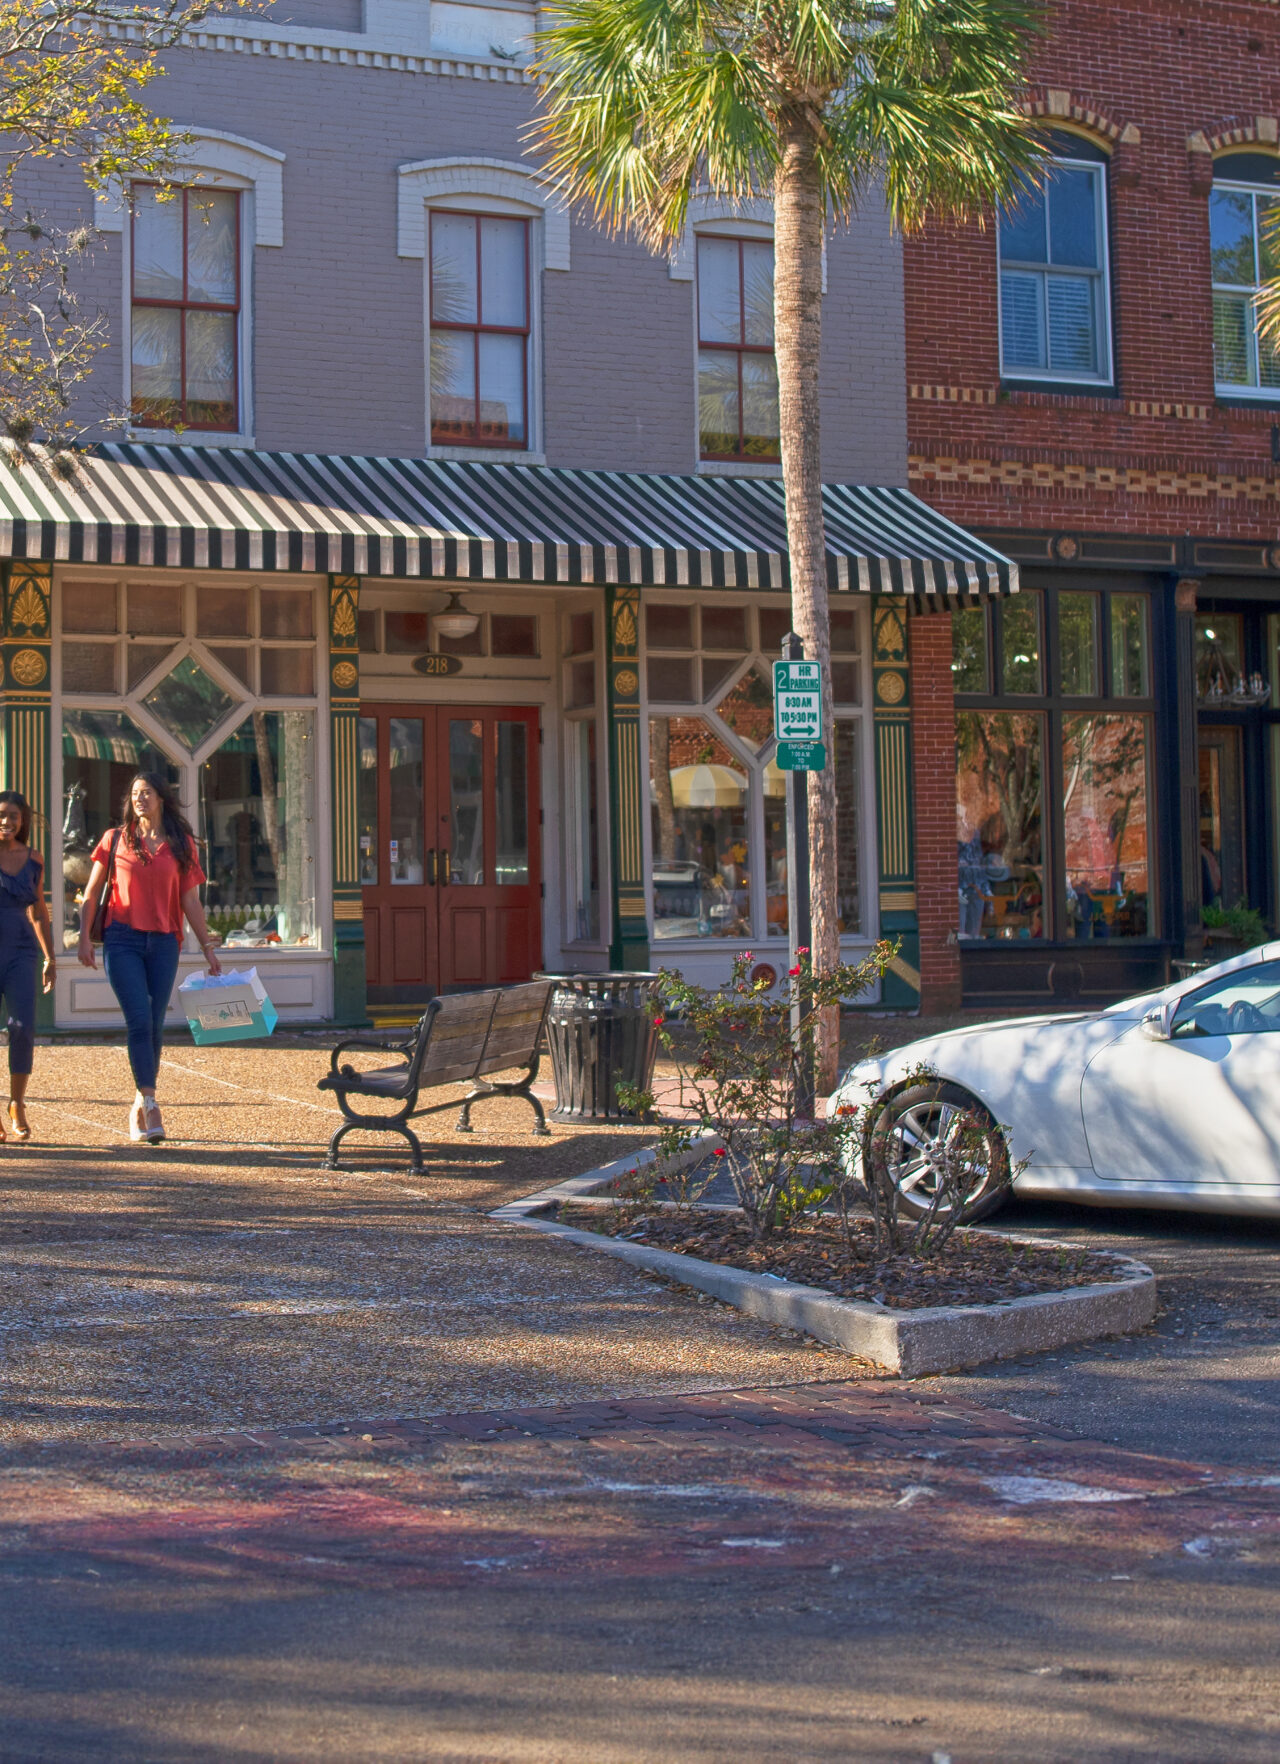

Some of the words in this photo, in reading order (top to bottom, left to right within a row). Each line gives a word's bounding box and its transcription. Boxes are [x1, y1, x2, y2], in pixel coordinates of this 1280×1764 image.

[426, 657, 449, 673] 218
[777, 669, 787, 689] 2
[798, 666, 811, 676] HR
[790, 678, 819, 689] PARKING
[785, 697, 801, 708] 8:30
[801, 697, 811, 707] AM
[781, 712, 790, 723] TO
[807, 712, 817, 723] PM
